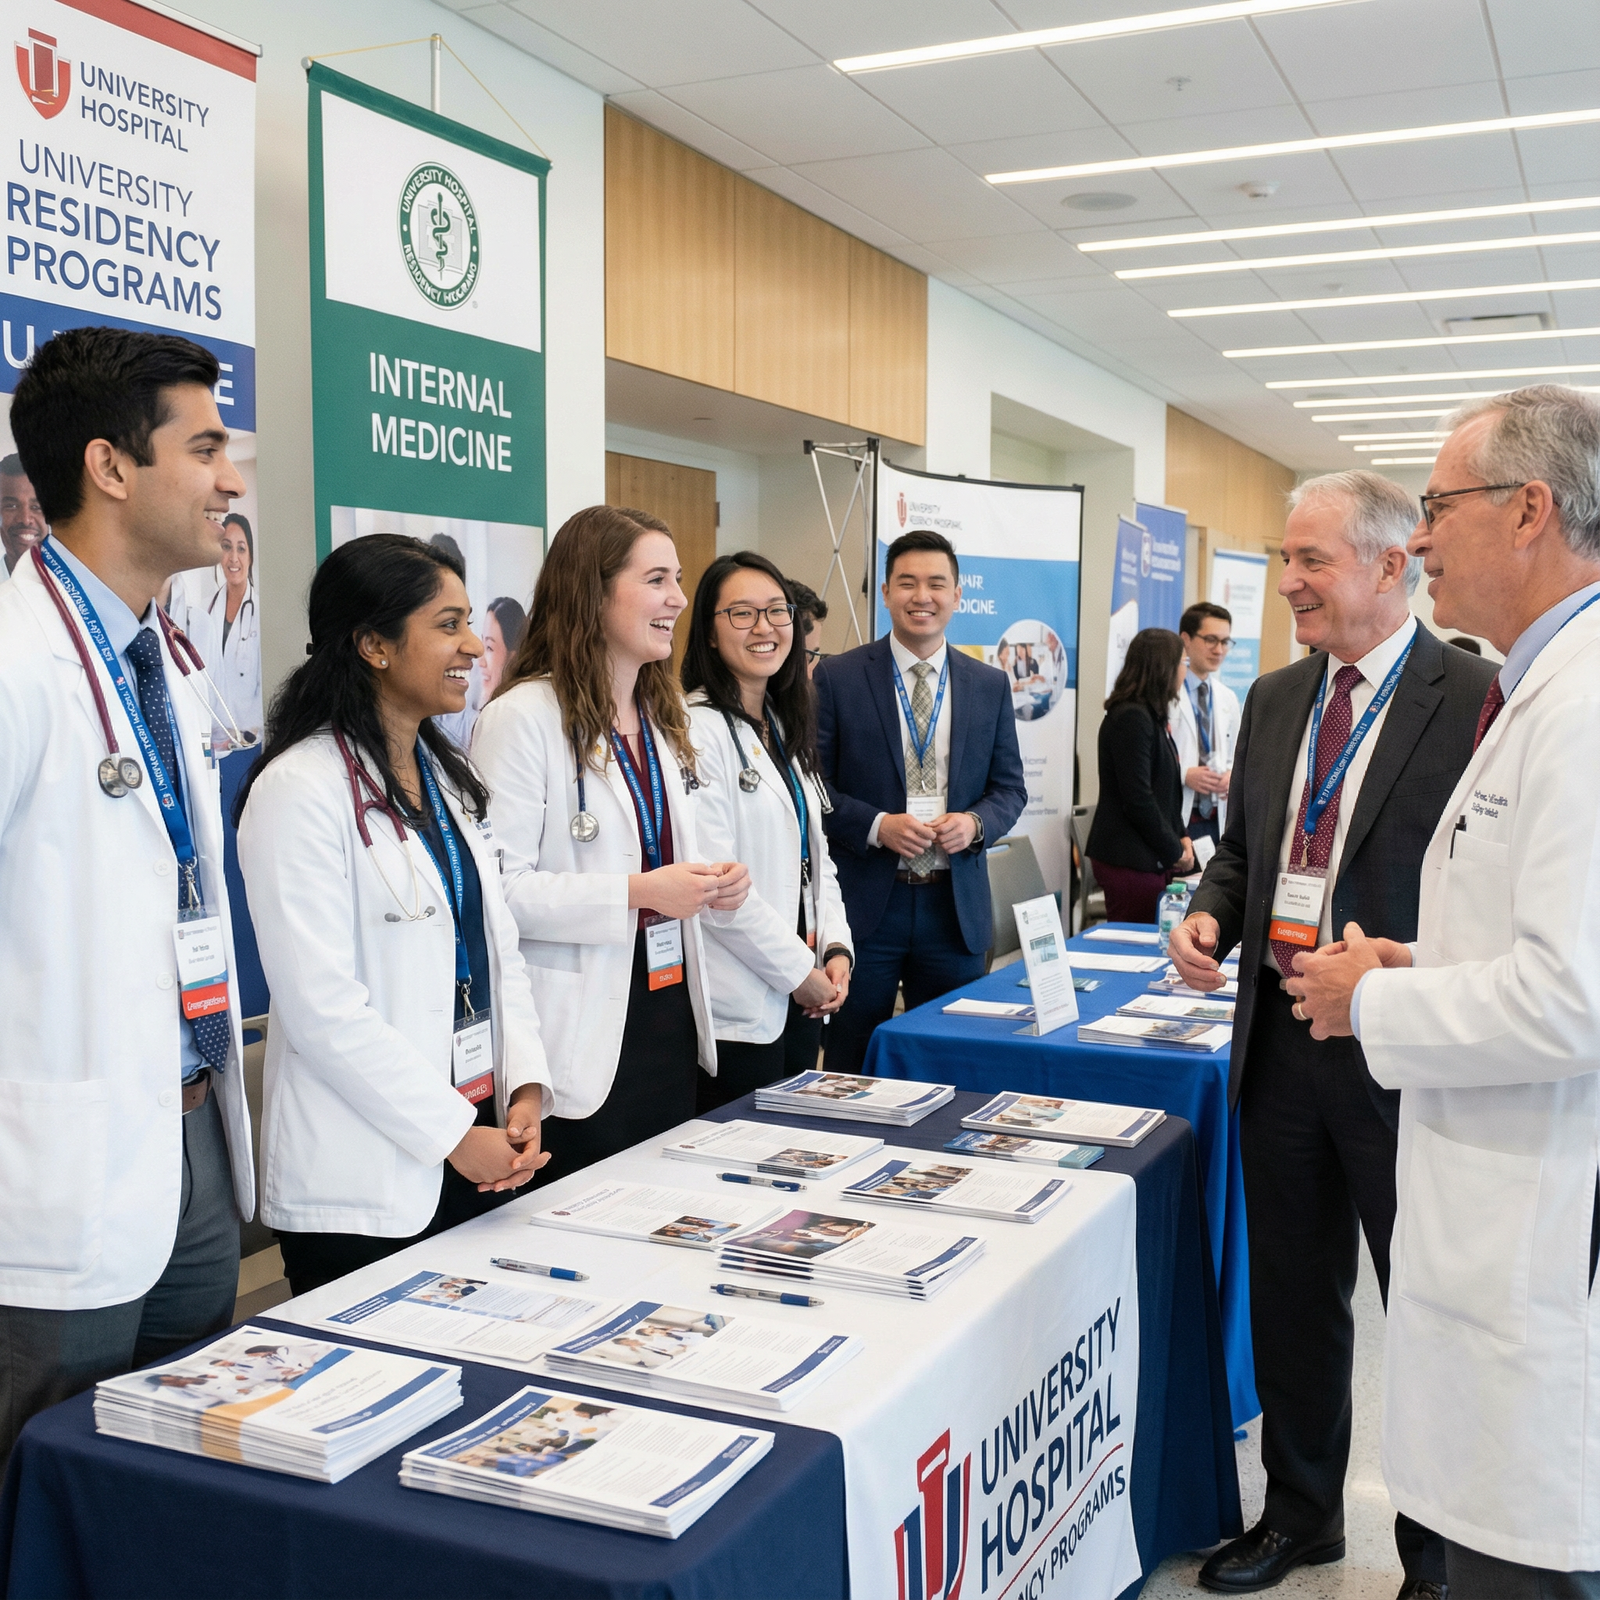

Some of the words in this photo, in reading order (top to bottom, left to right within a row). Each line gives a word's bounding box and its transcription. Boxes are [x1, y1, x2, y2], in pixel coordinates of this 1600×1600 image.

[80, 61, 209, 127] UNIVERSITY
[81, 95, 188, 152] HOSPITAL
[19, 138, 193, 217] UNIVERSITY
[402, 169, 443, 213] UNIVERSITY
[444, 175, 477, 235] HOSPITAL
[7, 181, 220, 272] RESIDENCY
[7, 235, 222, 321] PROGRAMS
[370, 352, 512, 419] INTERNAL
[372, 412, 512, 473] MEDICINE
[953, 598, 998, 615] DICINE.
[981, 1296, 1121, 1496] UNIVERSITY
[981, 1371, 1121, 1595] HOSPITAL
[1051, 1465, 1126, 1581] PROGRAMS
